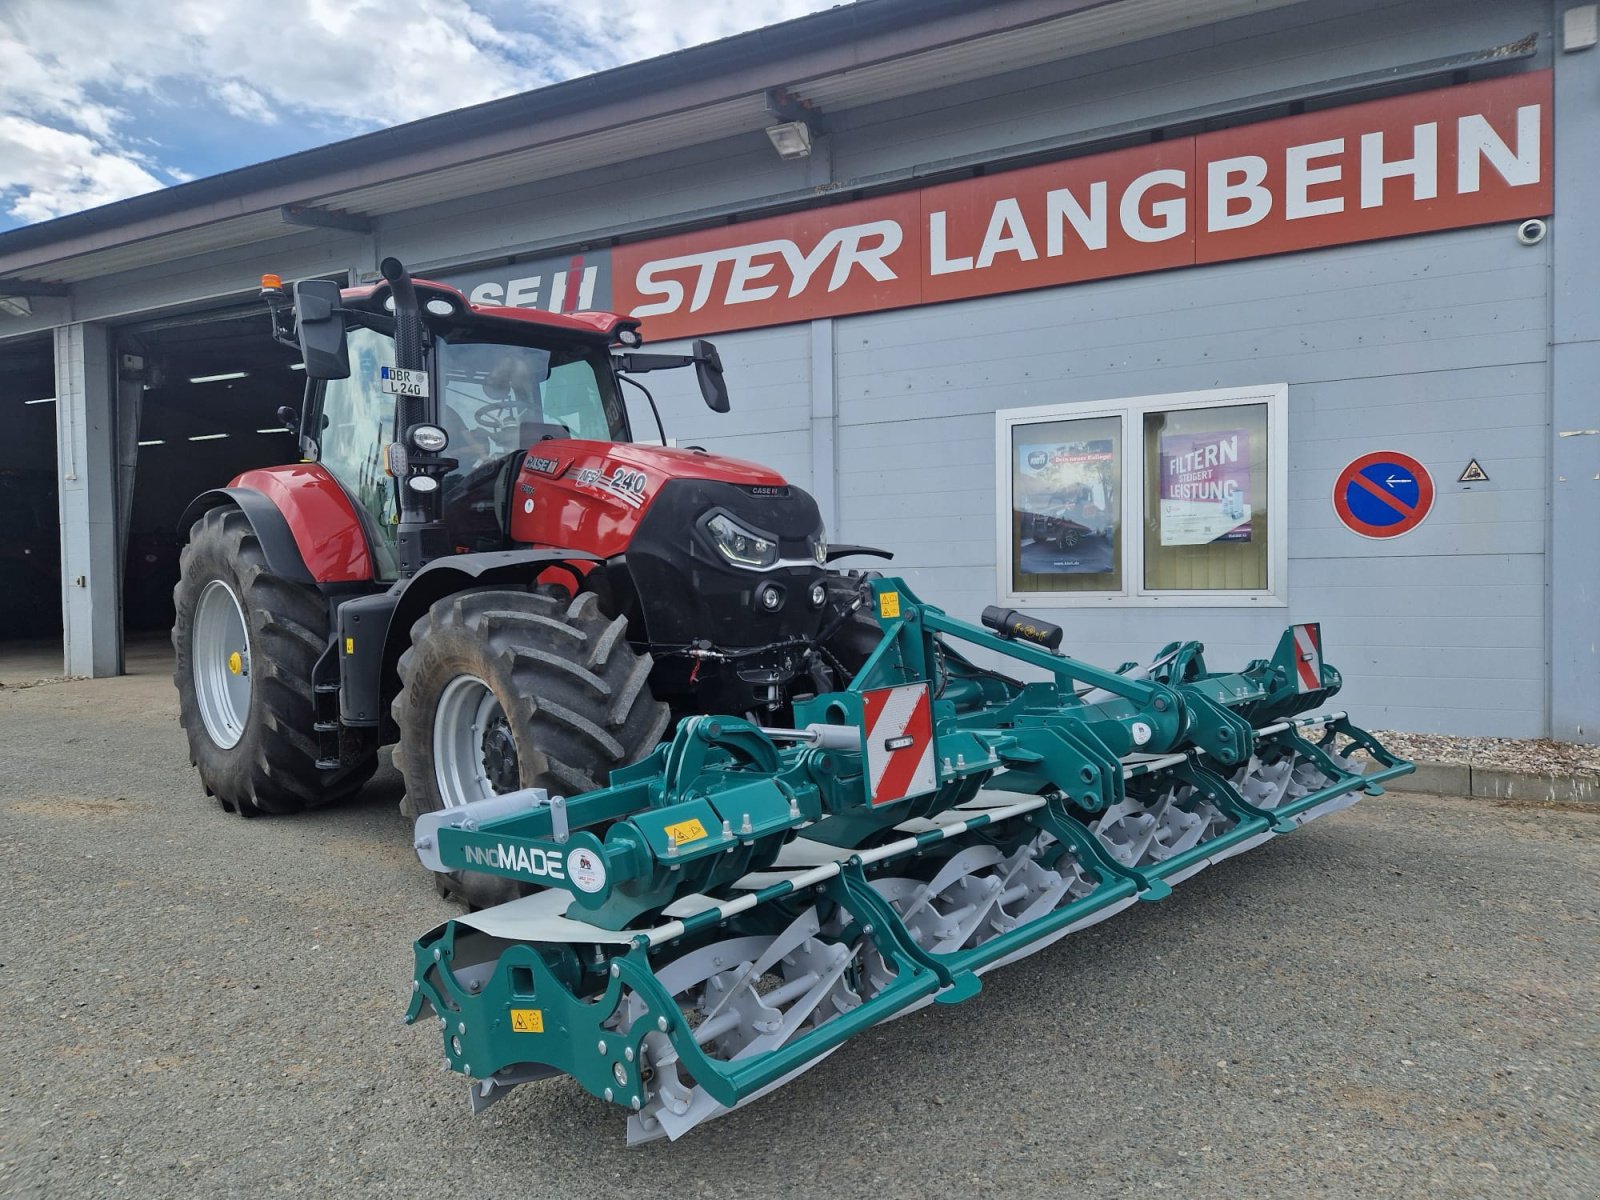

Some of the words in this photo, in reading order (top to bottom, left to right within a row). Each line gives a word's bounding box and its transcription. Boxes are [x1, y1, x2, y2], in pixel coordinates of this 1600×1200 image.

[629, 218, 903, 318] STEYR
[930, 104, 1541, 276] LANGBEHN
[390, 369, 410, 382] DBR
[391, 381, 398, 392] L
[525, 455, 550, 472] CASE
[1170, 435, 1238, 475] FILTERN
[611, 468, 647, 493] 240
[1179, 469, 1214, 482] STEIGERT
[1170, 479, 1238, 500] LEISTUNG
